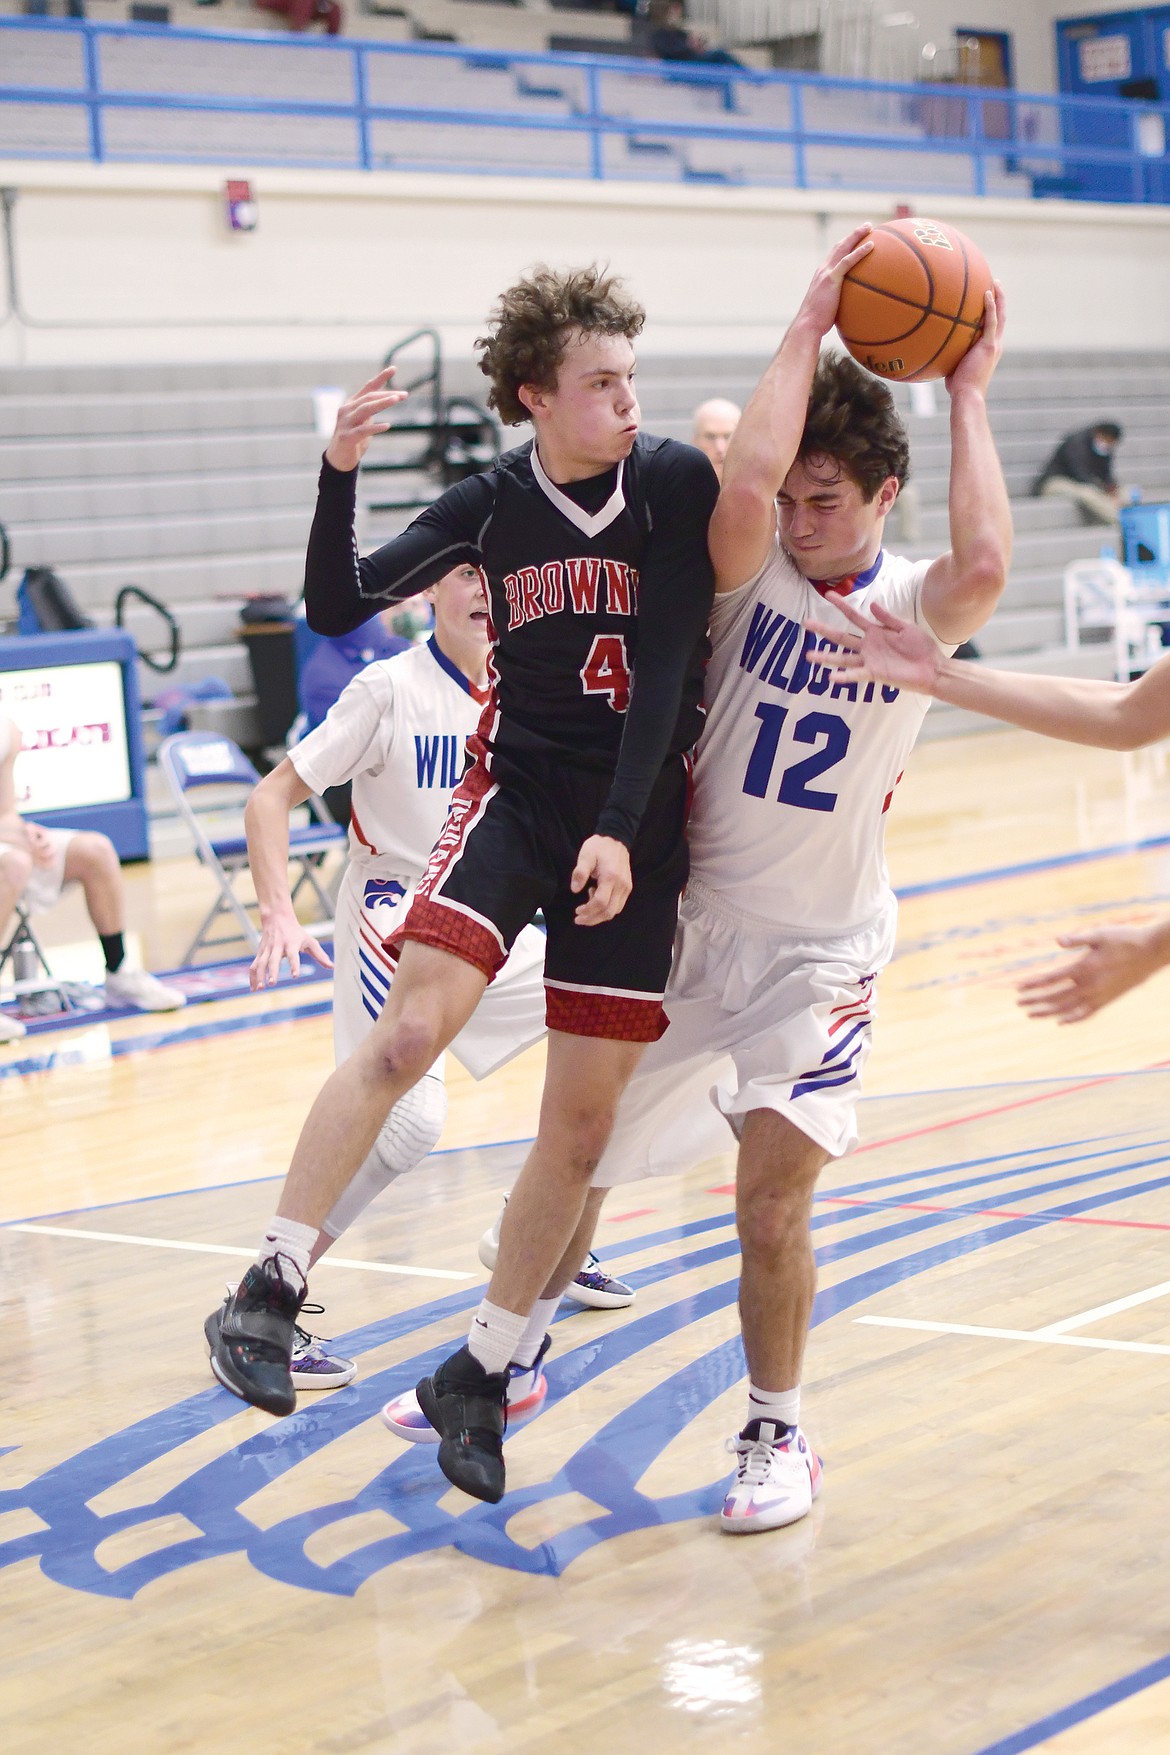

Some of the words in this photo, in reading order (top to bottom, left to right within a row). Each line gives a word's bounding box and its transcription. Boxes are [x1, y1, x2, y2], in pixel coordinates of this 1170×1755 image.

[864, 355, 904, 372] den
[580, 634, 631, 714] 4
[414, 735, 468, 788] WIL
[742, 701, 850, 812] 12
